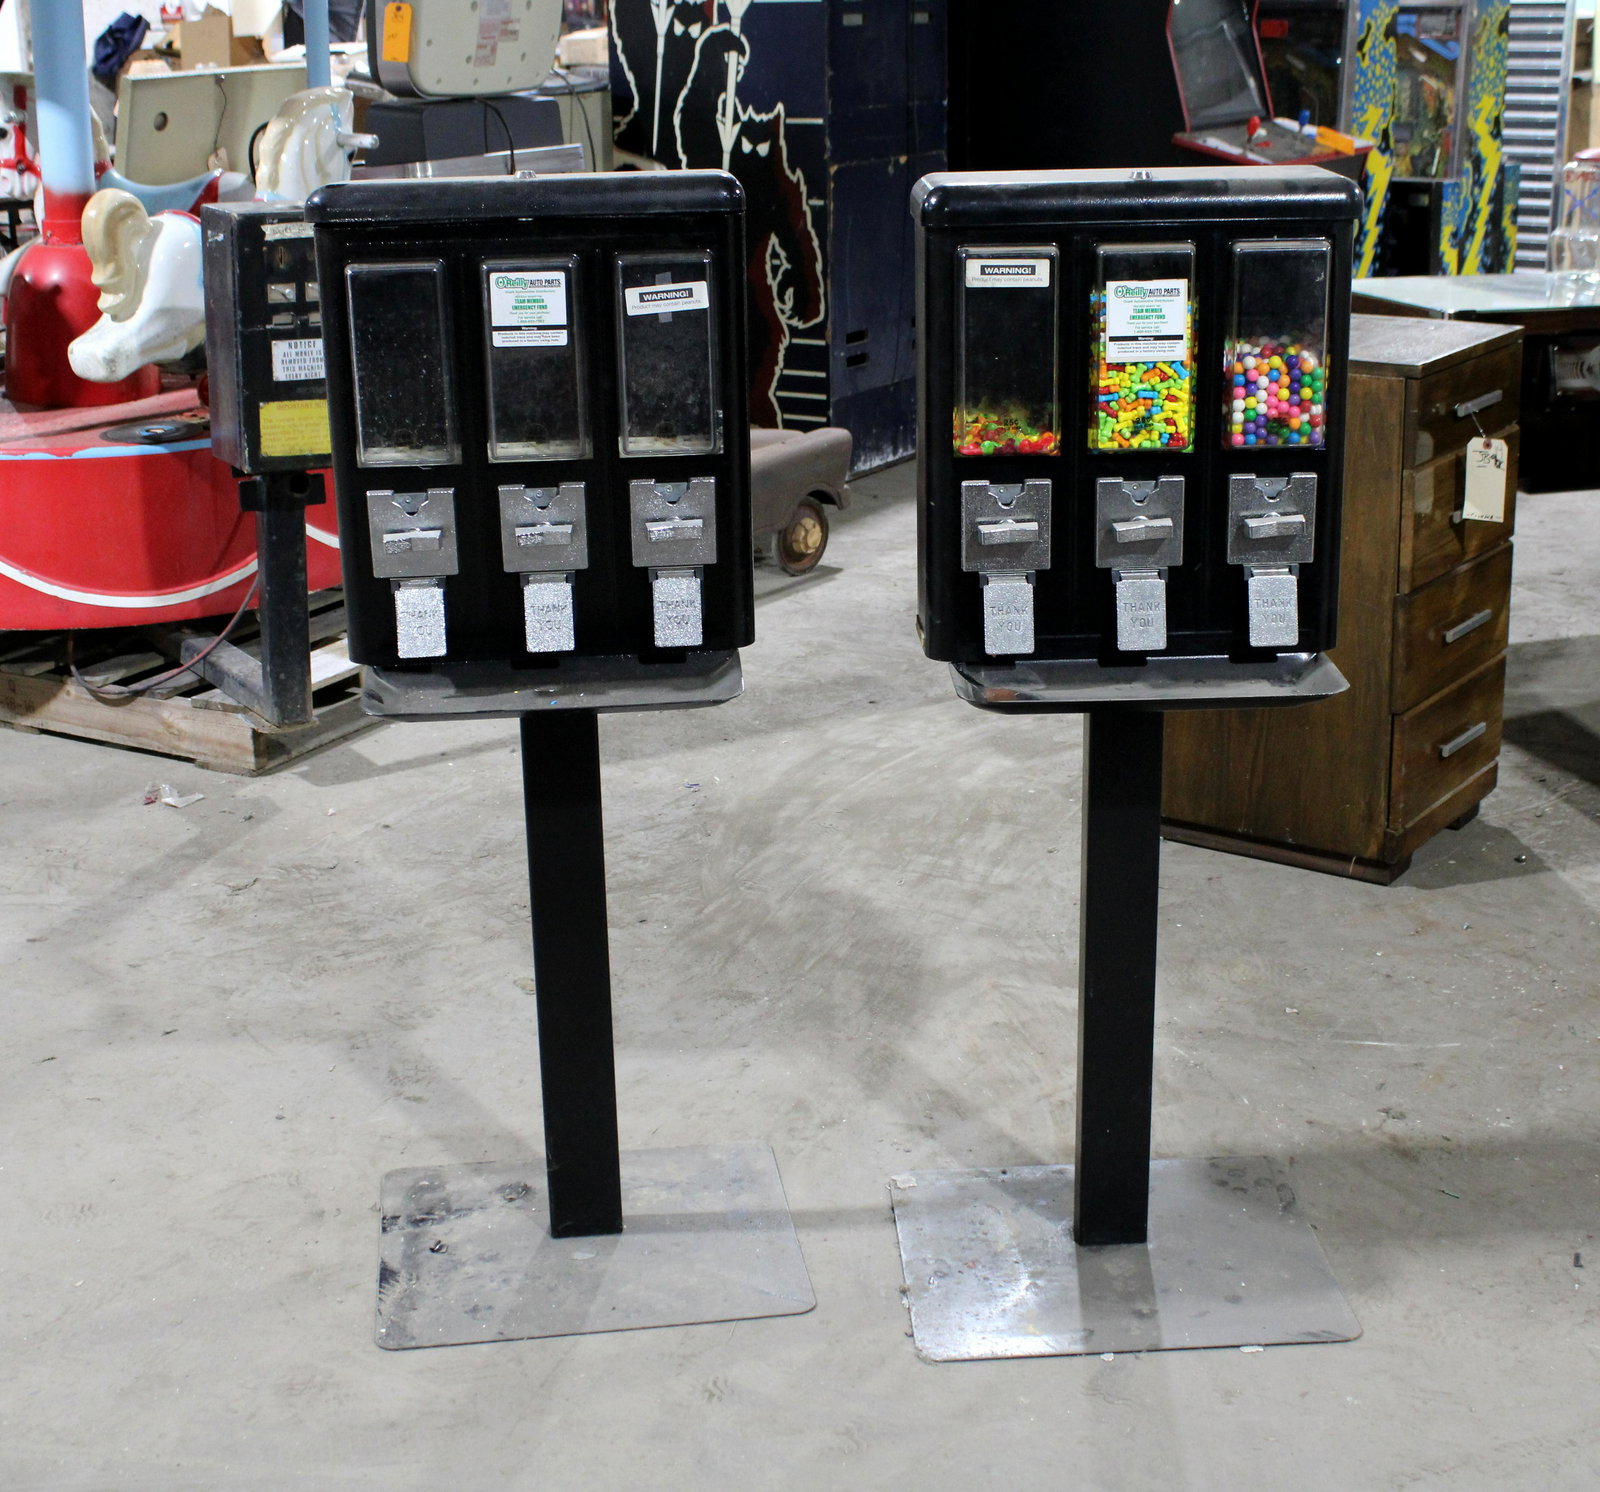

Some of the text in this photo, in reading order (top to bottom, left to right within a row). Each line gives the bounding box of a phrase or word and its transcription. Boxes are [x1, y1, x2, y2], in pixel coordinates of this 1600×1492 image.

[495, 276, 528, 290] O'Reilly
[643, 290, 689, 301] WARNING!
[1114, 285, 1147, 299] O'Reilly
[288, 341, 316, 349] NOTICE
[530, 603, 567, 615] THANK
[659, 599, 696, 611] THANK
[1122, 601, 1161, 613] THANK
[1254, 597, 1293, 609] THANK
[989, 605, 1028, 617] THANK
[666, 614, 690, 626] YOU
[1130, 617, 1154, 628] YOU
[1262, 613, 1286, 624] YOU
[536, 619, 562, 631] YOU
[997, 621, 1022, 632] YOU
